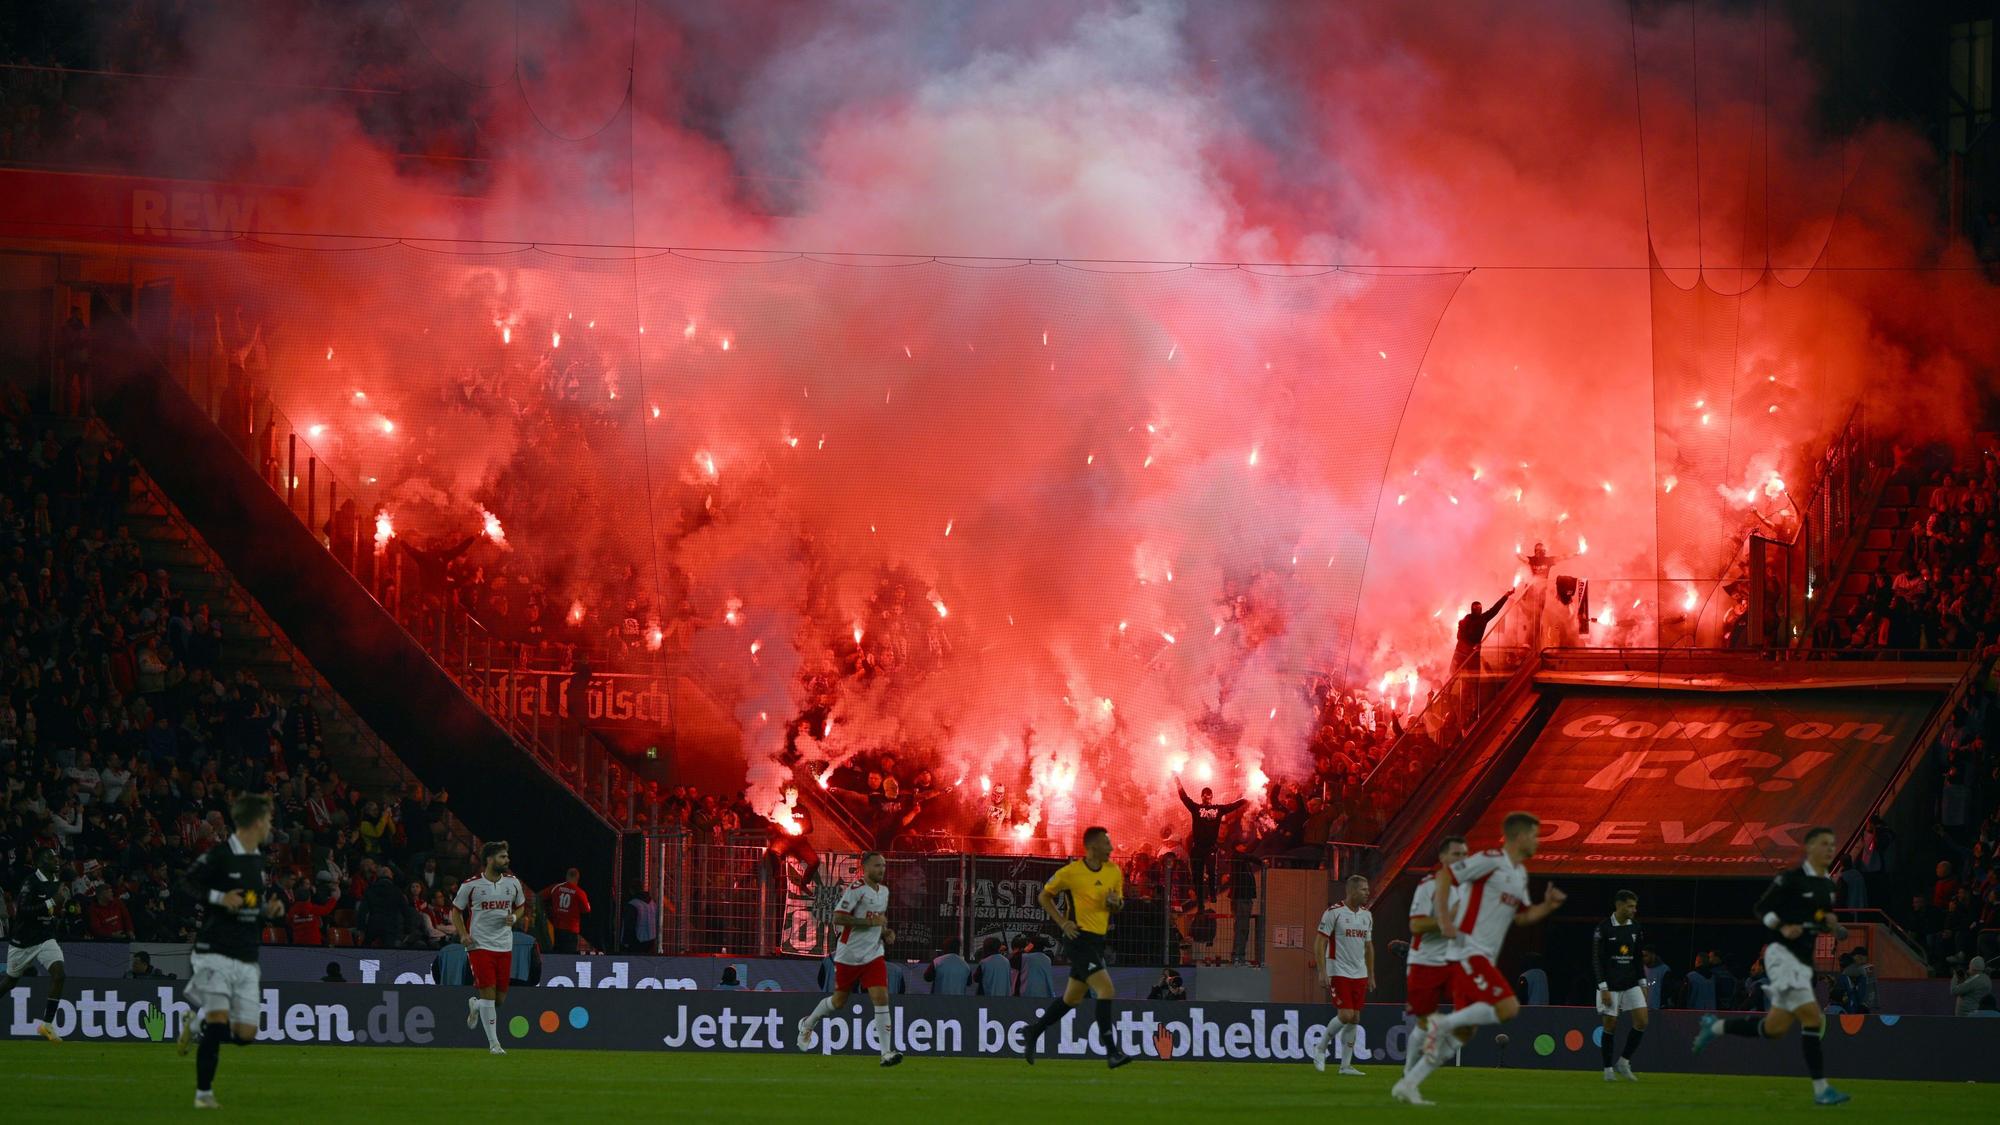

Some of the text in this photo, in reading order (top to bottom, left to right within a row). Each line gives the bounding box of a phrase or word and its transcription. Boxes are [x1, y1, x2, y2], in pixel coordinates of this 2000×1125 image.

[1562, 714, 1895, 744] Come on,
[1583, 749, 1836, 792] FC!
[1500, 819, 1812, 847] DEVK
[1583, 853, 1663, 863] Getan.
[481, 900, 510, 910] REWE
[946, 877, 1066, 907] PAST
[10, 986, 435, 1044] Lottohden.de
[662, 1004, 785, 1048] Jetzt
[1057, 1007, 1412, 1060] Lottohelden.d
